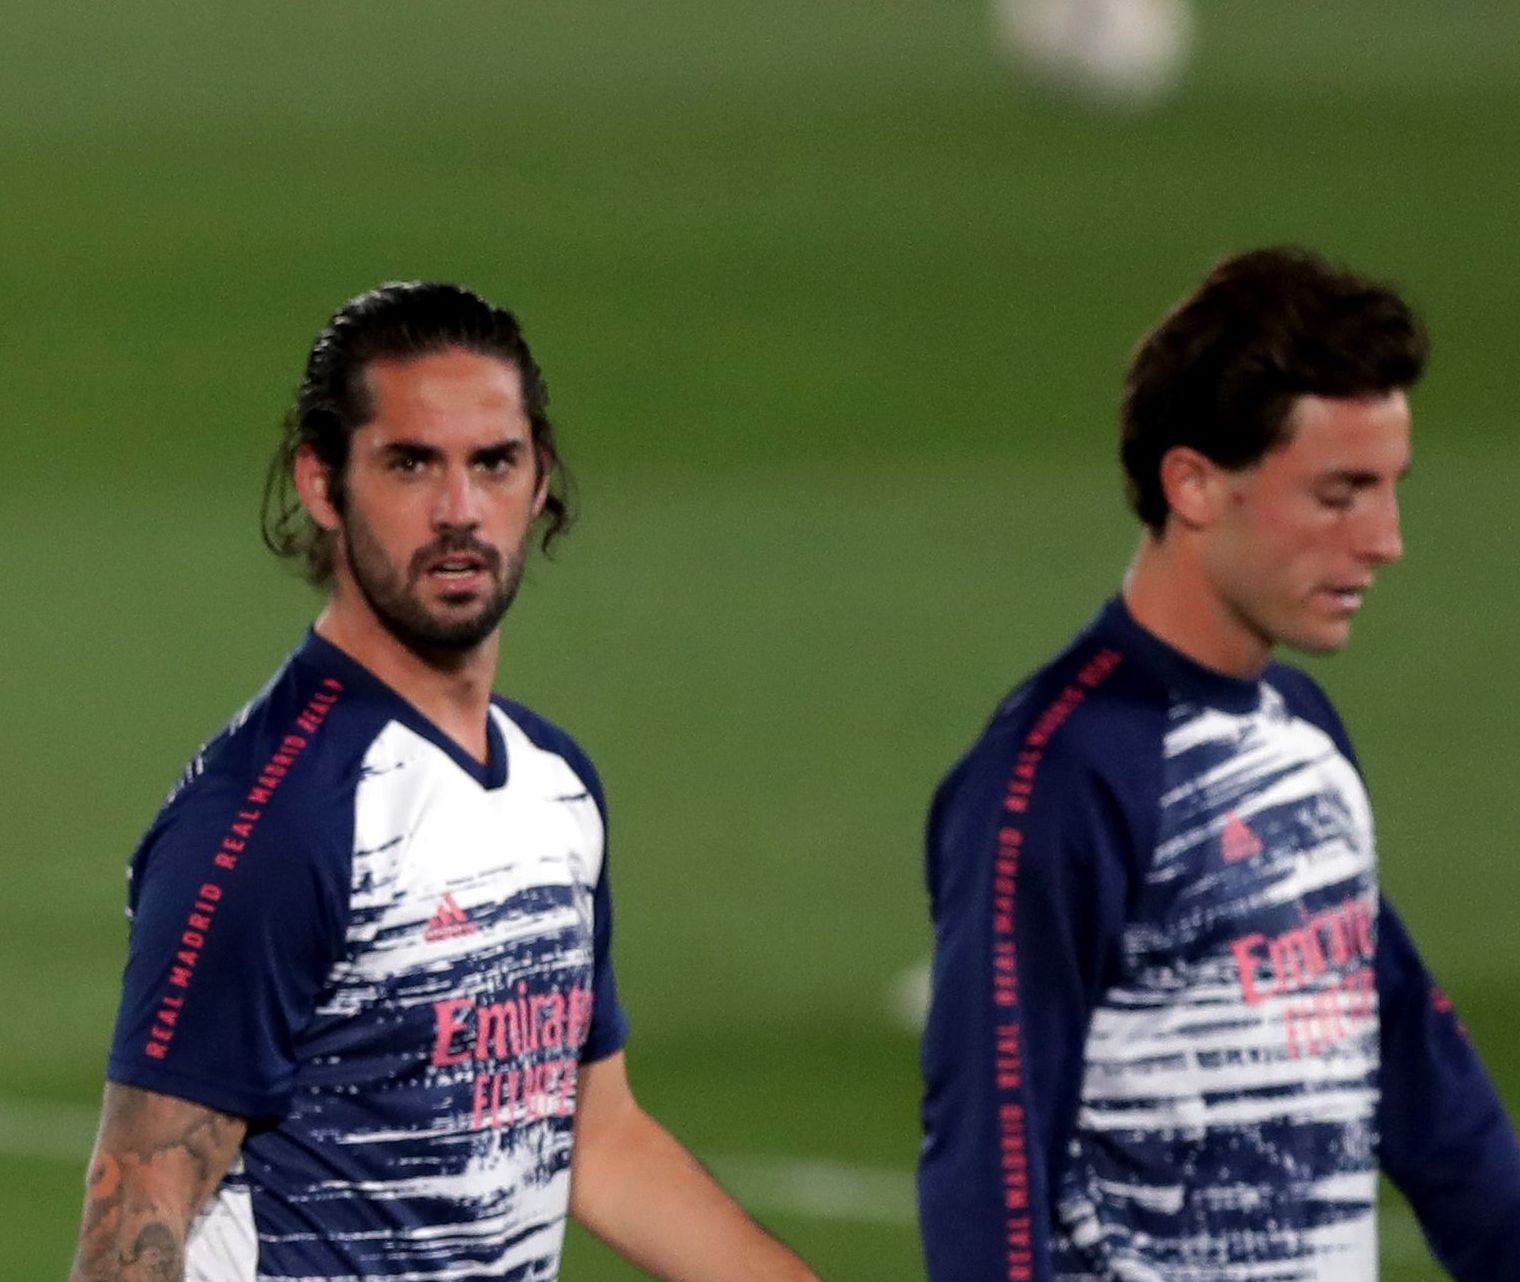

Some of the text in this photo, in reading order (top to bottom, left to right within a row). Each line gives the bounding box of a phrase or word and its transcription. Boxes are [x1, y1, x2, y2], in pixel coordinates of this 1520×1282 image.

[144, 996, 185, 1060] REAL
[168, 883, 224, 988] MADRID
[213, 810, 261, 871] REAL
